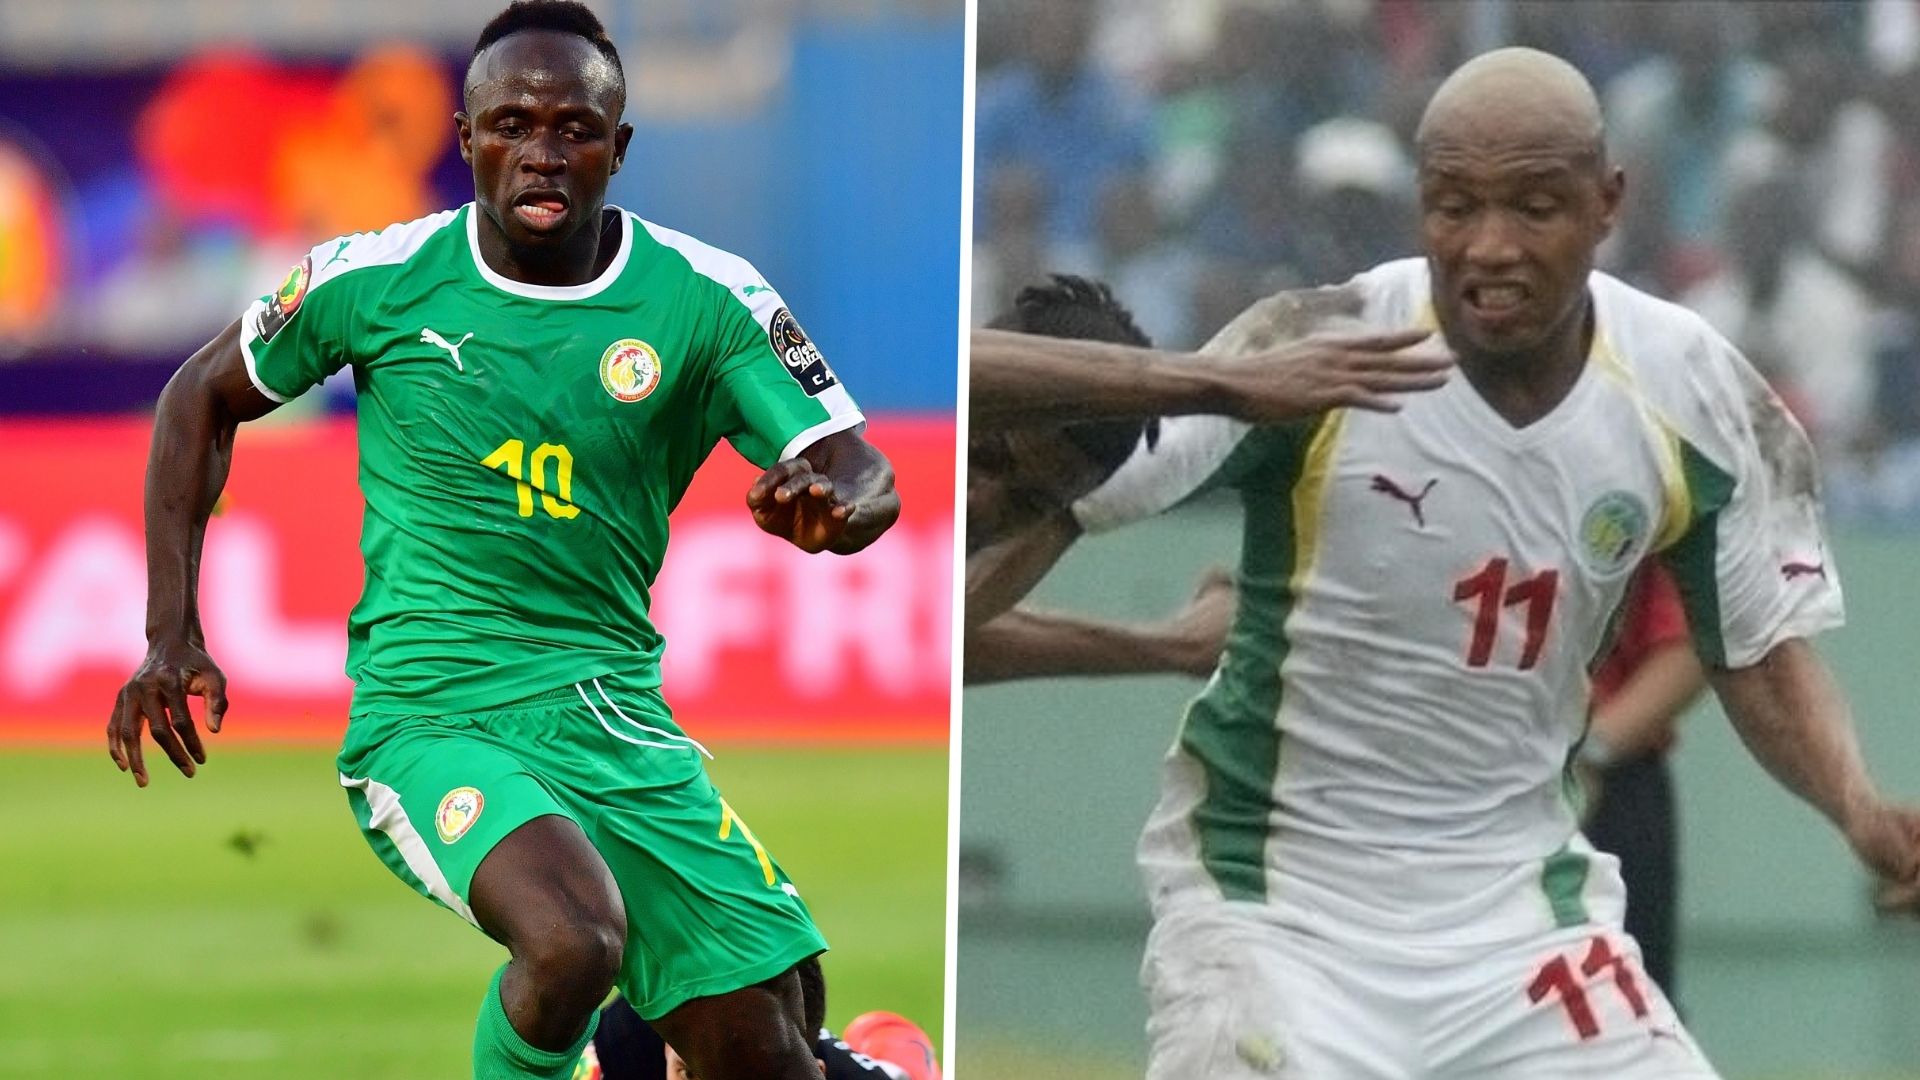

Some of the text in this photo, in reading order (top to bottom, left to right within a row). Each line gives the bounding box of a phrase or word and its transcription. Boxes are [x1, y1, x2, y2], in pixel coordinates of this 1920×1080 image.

[479, 438, 581, 519] 10
[0, 512, 350, 700] AL
[1454, 557, 1558, 671] 11
[1527, 935, 1649, 1040] 11
